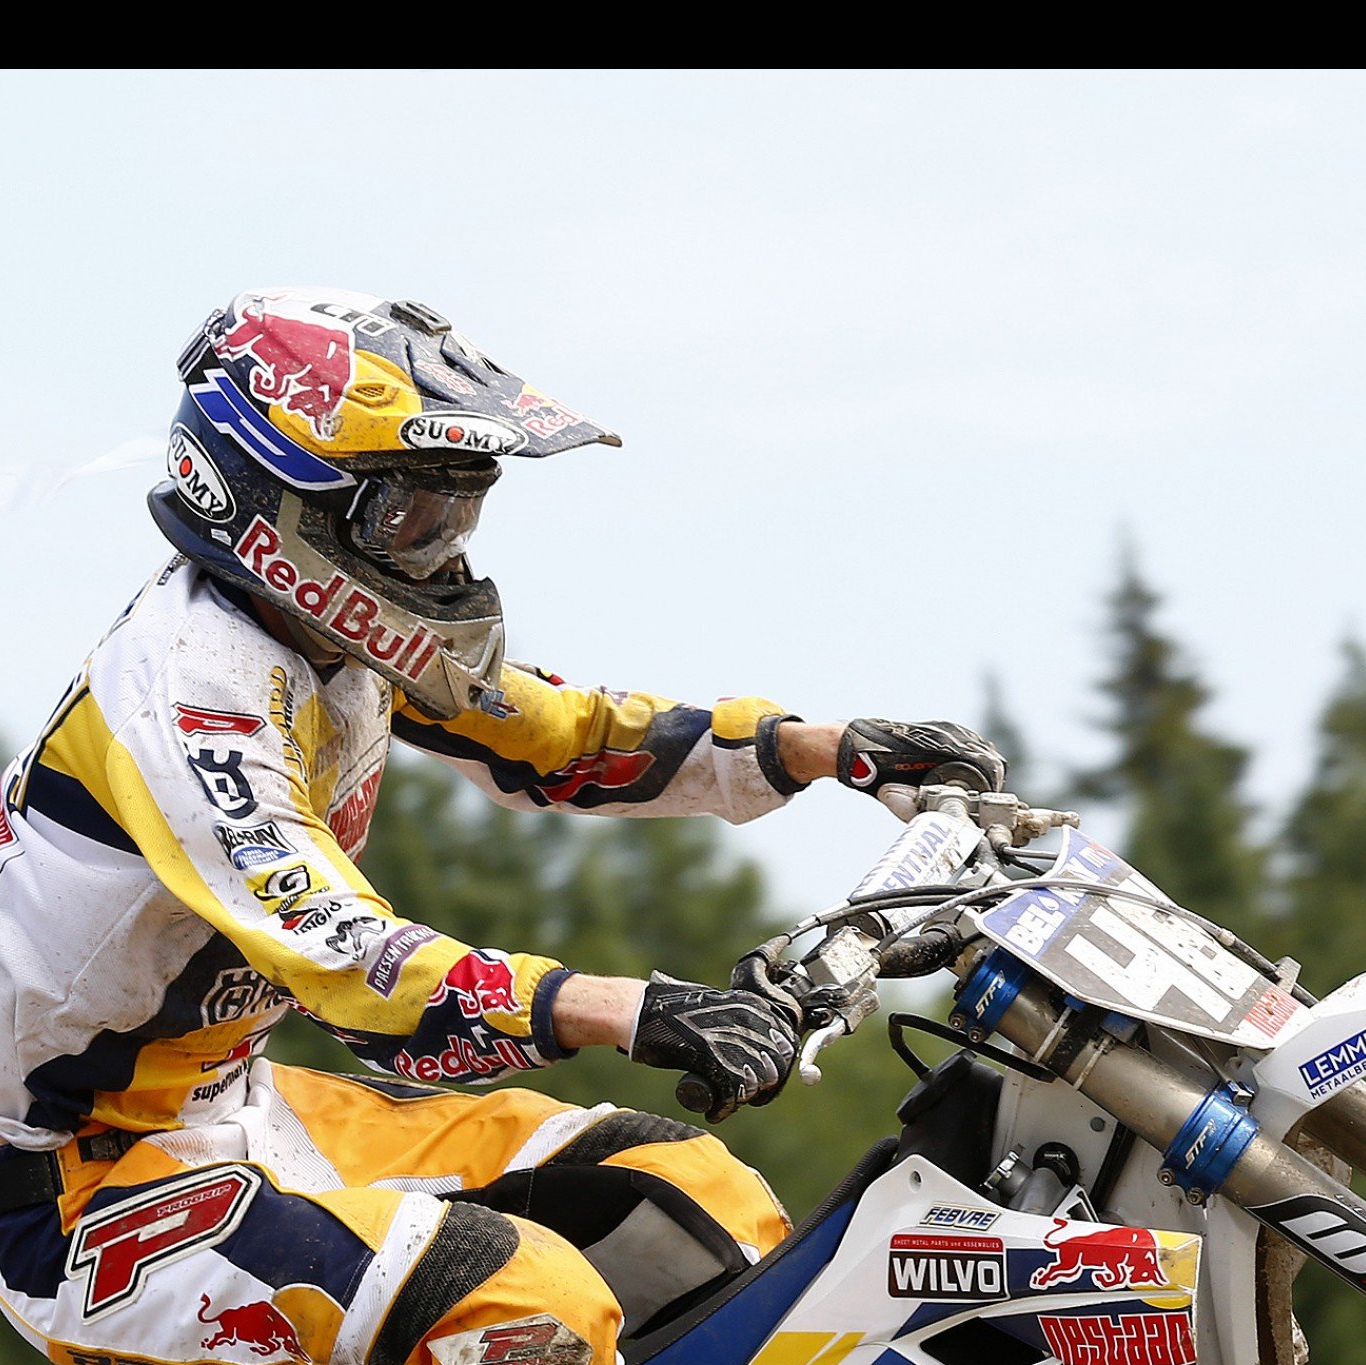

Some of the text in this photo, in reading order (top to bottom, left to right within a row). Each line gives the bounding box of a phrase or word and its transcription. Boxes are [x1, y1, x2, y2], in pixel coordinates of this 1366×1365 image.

[237, 515, 444, 683] Red Bull
[875, 821, 952, 893] ENTHAL
[1004, 903, 1067, 956] BEL
[394, 1035, 472, 1082] Red
[923, 1206, 997, 1227] FEBVRE
[892, 1257, 1001, 1293] WILVO
